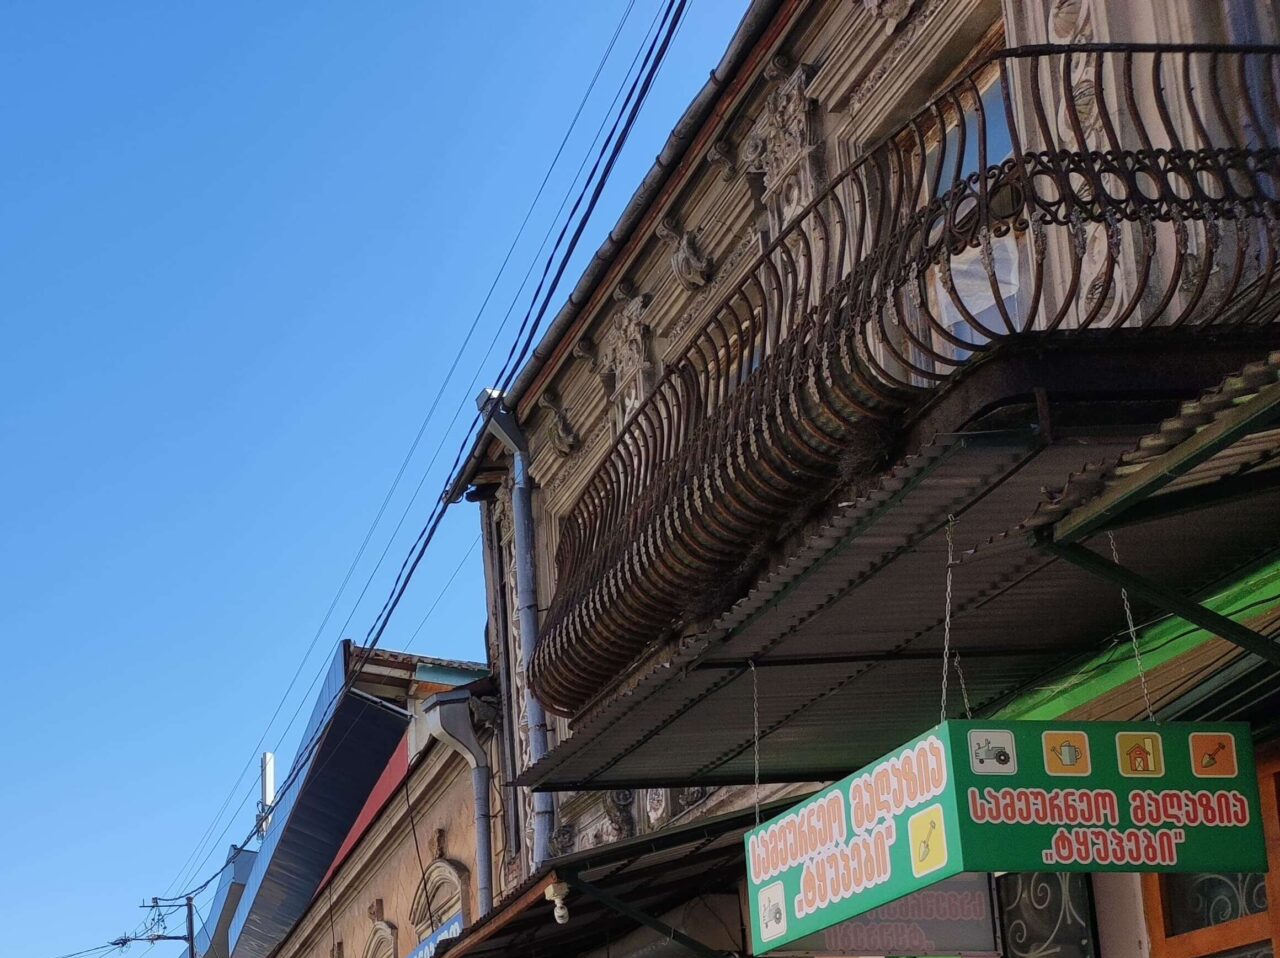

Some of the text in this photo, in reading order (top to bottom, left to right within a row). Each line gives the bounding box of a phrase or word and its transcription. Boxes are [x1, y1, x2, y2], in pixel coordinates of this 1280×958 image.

[749, 740, 946, 881] სამეურნეო მაღაზია
[969, 787, 1249, 825] სამეურნეო მაღაზია
